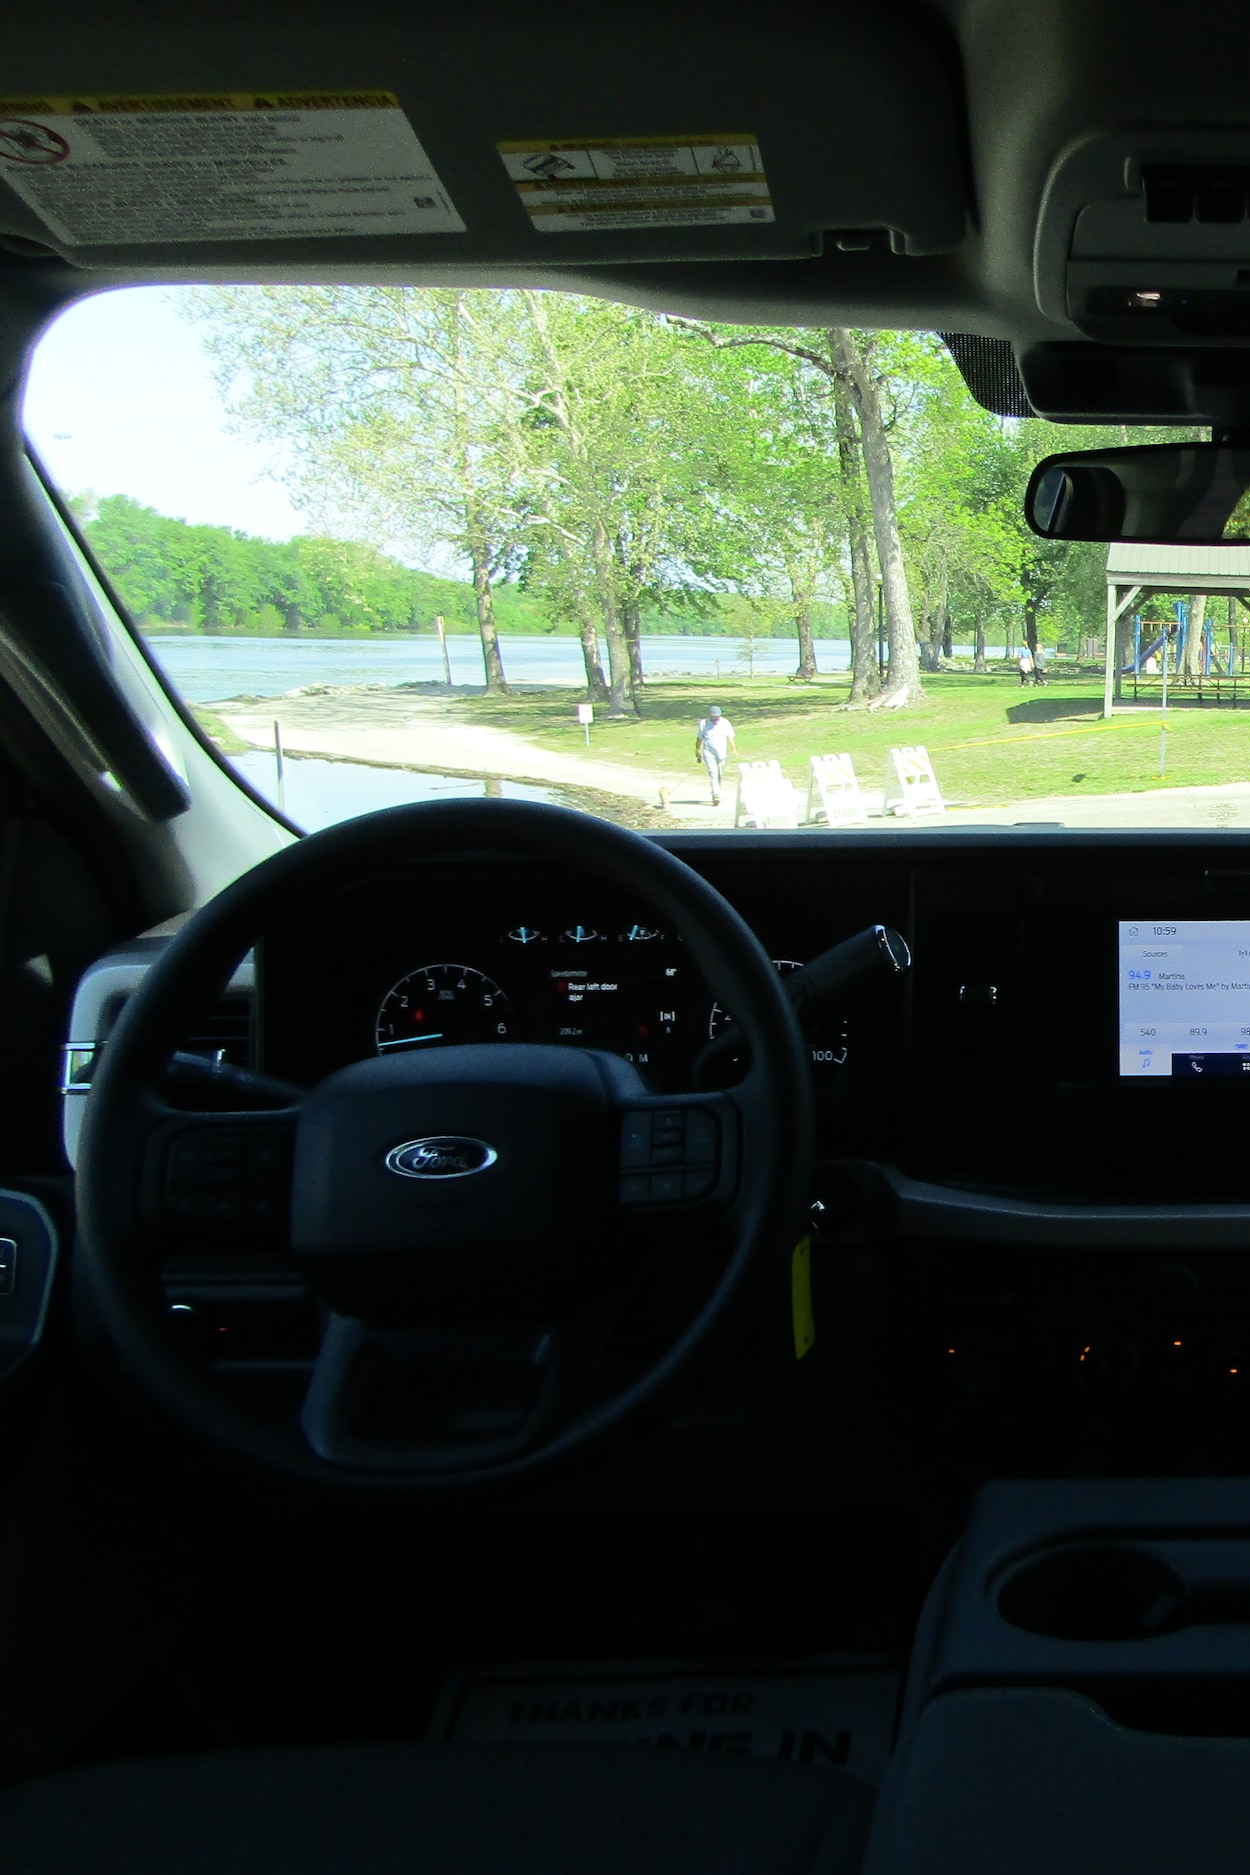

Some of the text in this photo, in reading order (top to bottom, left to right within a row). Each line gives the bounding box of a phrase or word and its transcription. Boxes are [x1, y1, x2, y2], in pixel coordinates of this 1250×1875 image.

[1152, 926, 1177, 936] 10:59
[1143, 950, 1168, 958] Sources
[1128, 970, 1185, 980] 94.9 Martina
[426, 979, 436, 991] 3
[456, 978, 467, 990] 4
[567, 982, 586, 991] Rear
[601, 982, 619, 991] door
[1166, 982, 1184, 991] Baby
[1185, 982, 1205, 990] Loves
[1221, 982, 1229, 991] by
[400, 995, 409, 1008] 2
[483, 995, 493, 1007] 5
[496, 1022, 507, 1035] 6
[1140, 1028, 1157, 1037] 540
[1189, 1028, 1208, 1037] 89.9
[812, 1050, 834, 1061] 100
[508, 1692, 756, 1724] THANKS FOR
[778, 1729, 853, 1767] IN
